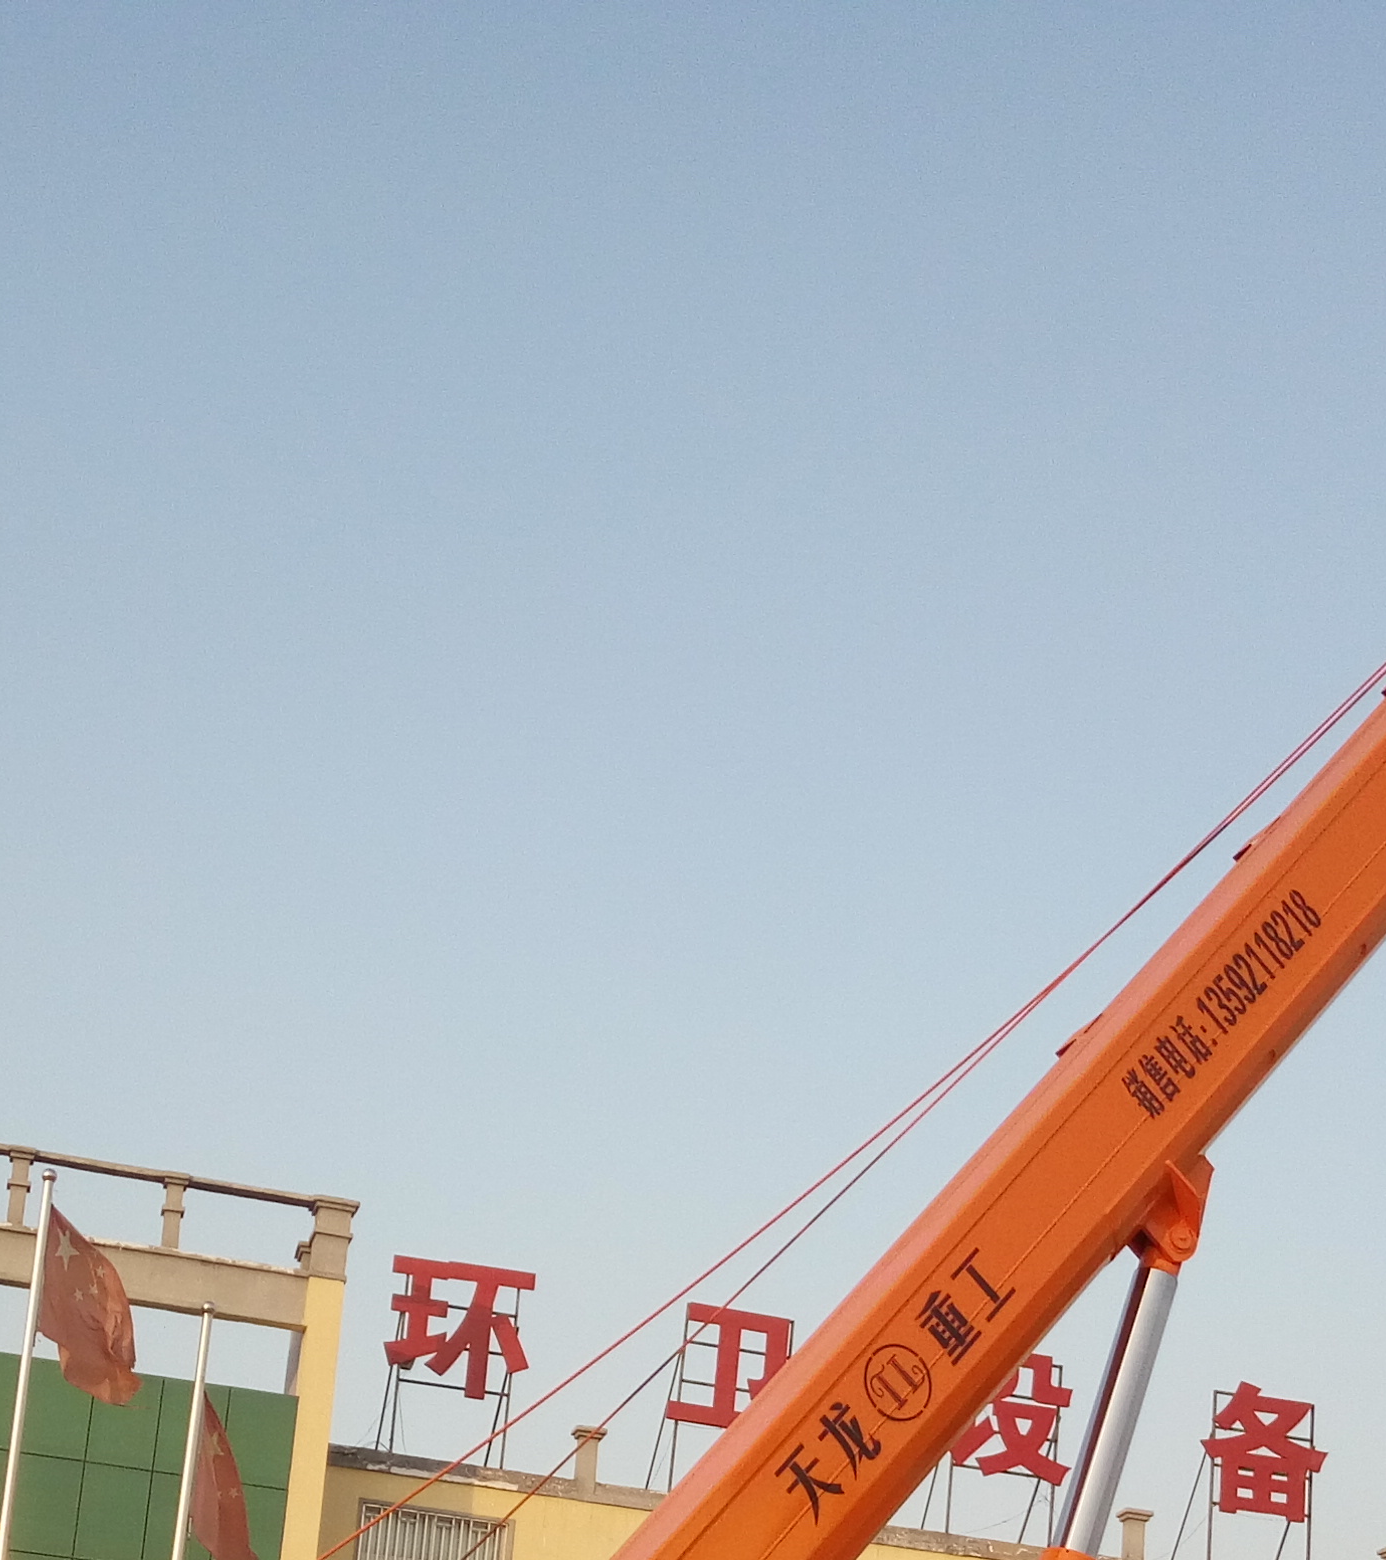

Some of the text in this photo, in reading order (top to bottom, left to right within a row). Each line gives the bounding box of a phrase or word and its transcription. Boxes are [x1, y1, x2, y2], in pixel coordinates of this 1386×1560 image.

[1121, 889, 1322, 1120] 销售电话:13592118218
[775, 1401, 881, 1524] 天龙
[917, 1248, 1015, 1363] 重工
